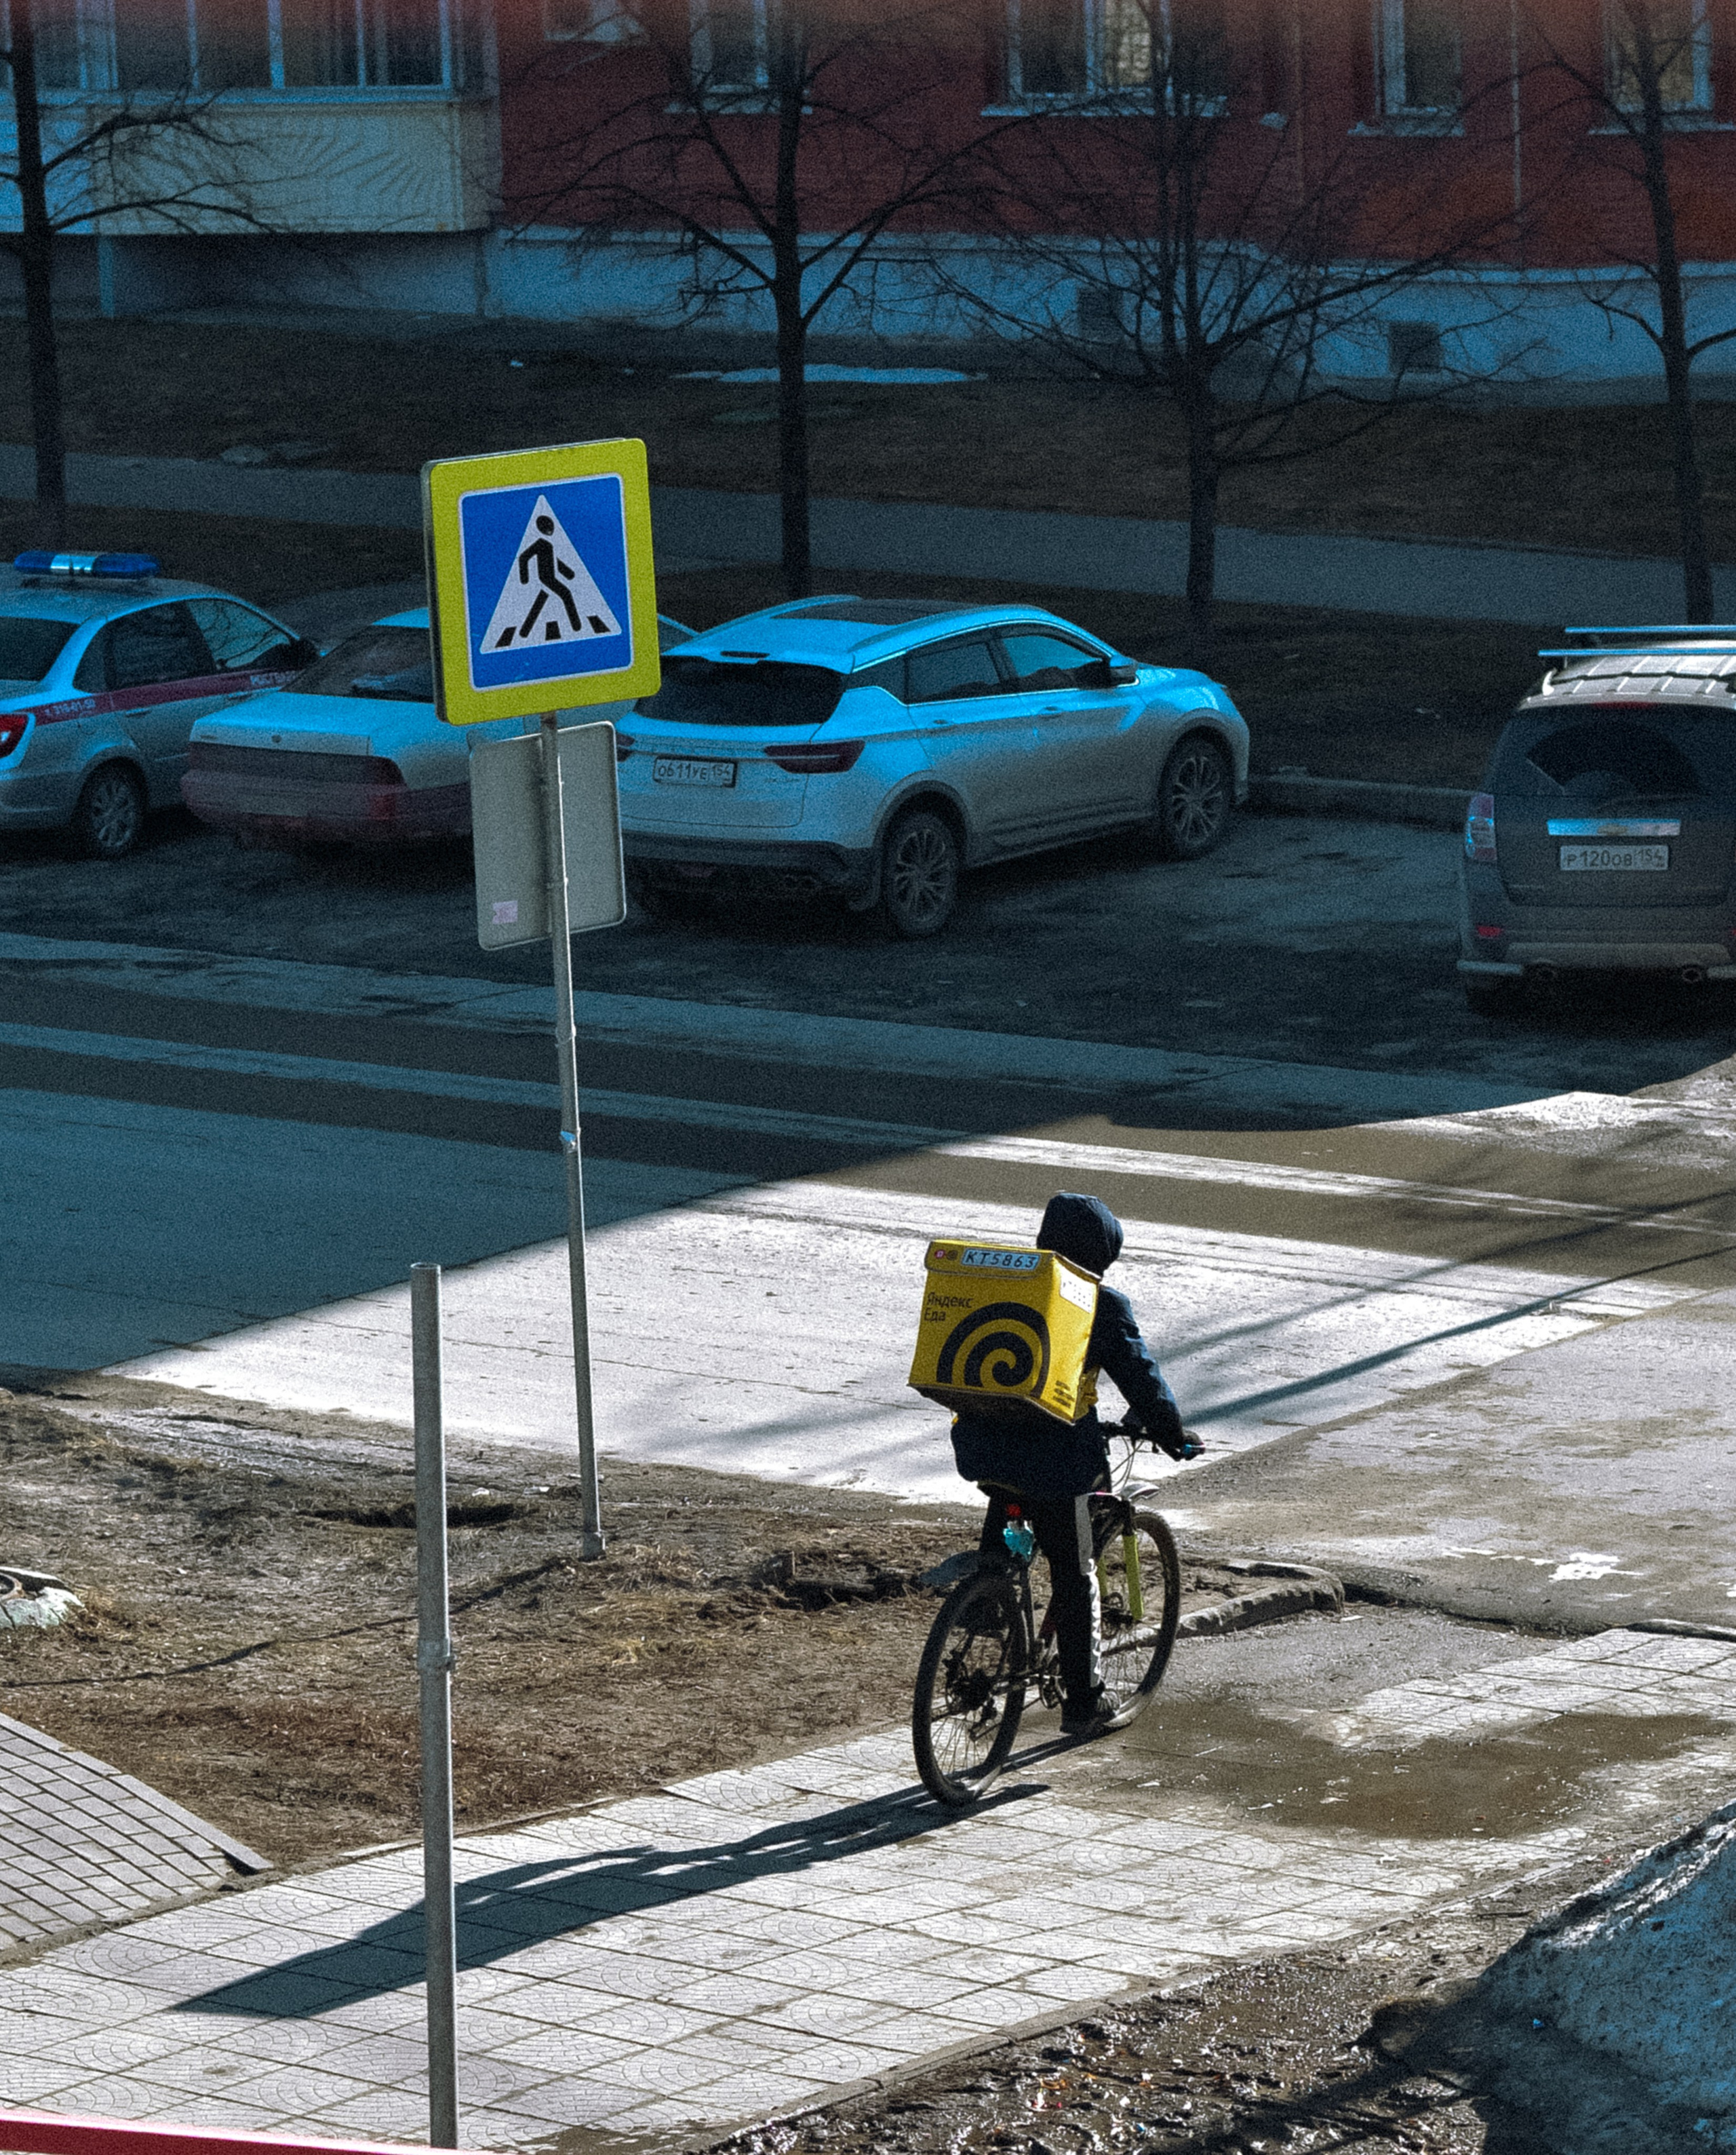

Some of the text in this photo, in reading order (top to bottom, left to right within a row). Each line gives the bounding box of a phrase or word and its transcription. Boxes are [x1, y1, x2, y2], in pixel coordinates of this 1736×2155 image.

[1636, 848, 1663, 862] 154
[926, 1292, 974, 1308] Яндекс
[924, 1307, 947, 1323] Еда
